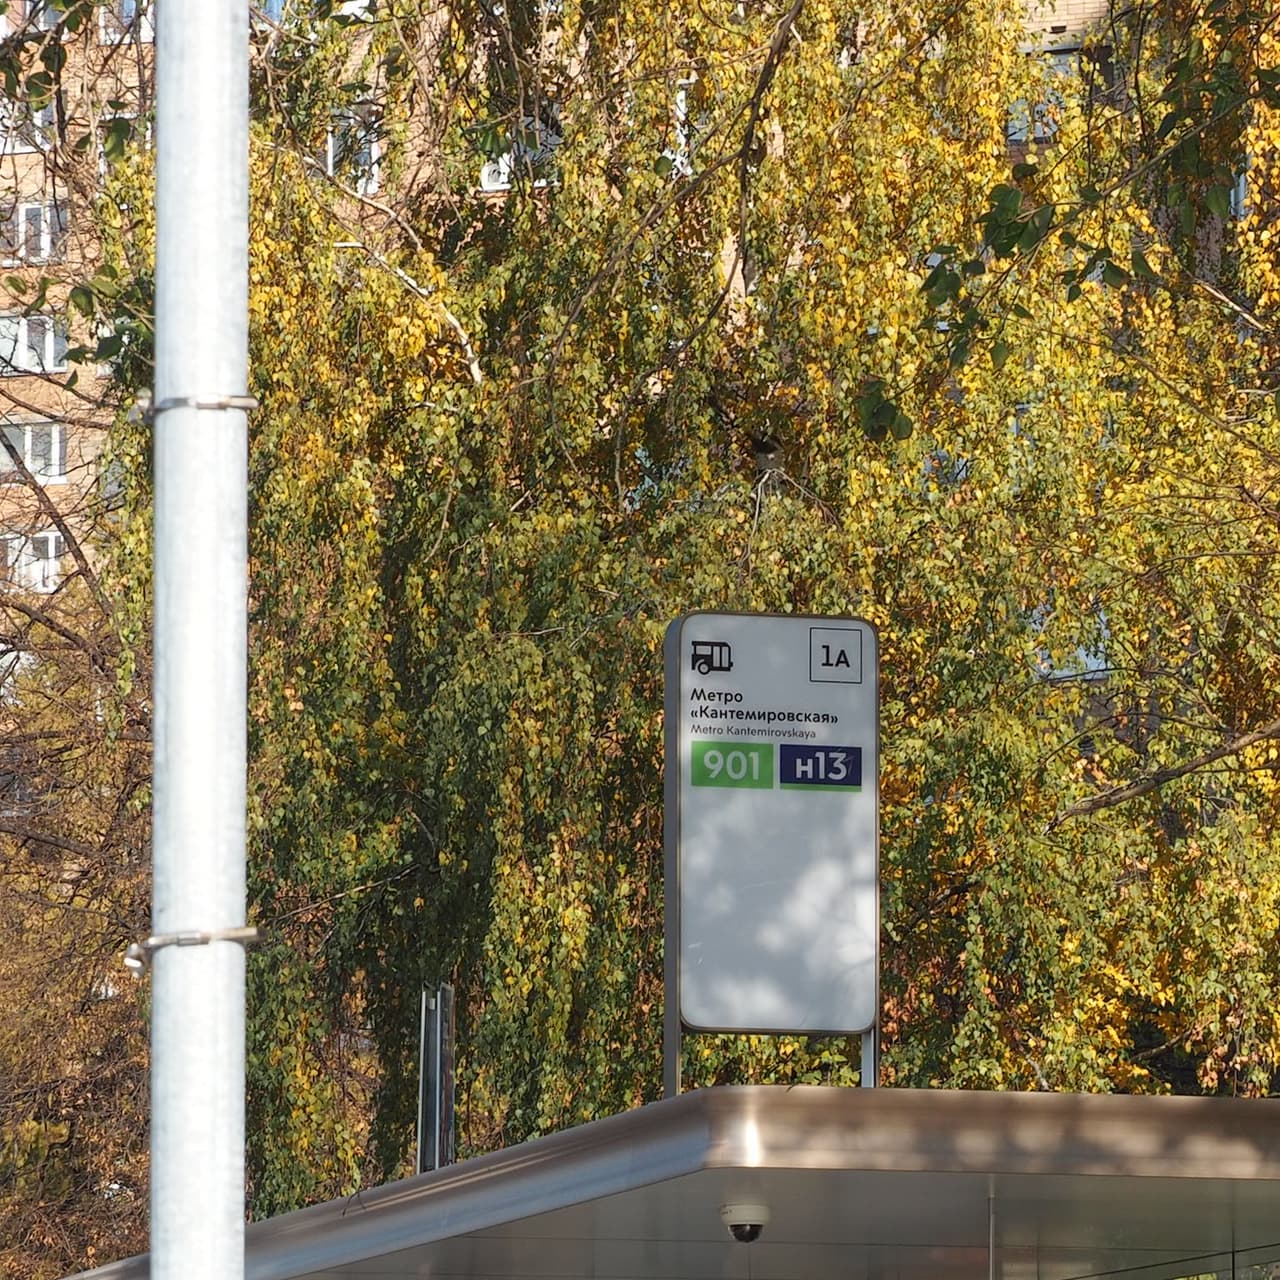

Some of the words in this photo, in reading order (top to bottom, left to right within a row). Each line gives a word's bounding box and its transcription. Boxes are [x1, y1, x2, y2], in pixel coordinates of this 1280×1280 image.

[690, 687, 744, 707] Метро
[690, 706, 839, 725] «Кантемировская»
[690, 724, 723, 737] Metro
[726, 725, 817, 740] Kantemirovskaya
[703, 750, 760, 780] 901
[795, 753, 848, 782] н13
